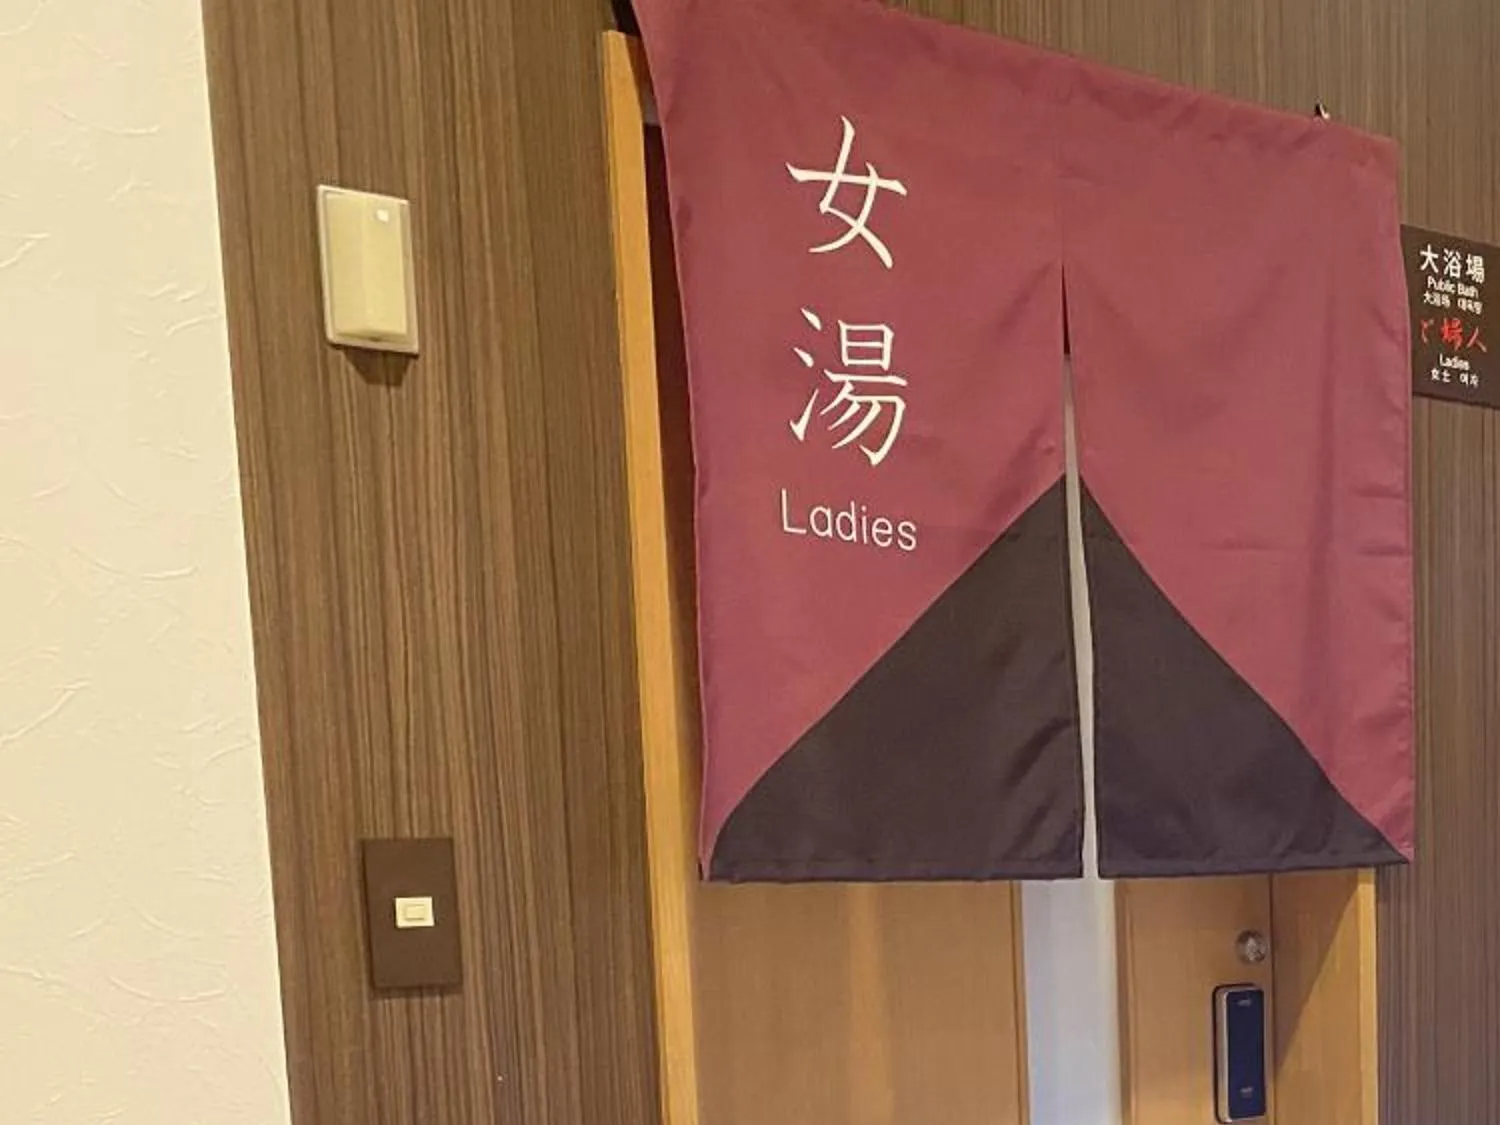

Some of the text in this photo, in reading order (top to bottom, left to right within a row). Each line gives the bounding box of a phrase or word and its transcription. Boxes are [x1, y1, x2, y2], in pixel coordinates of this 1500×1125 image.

[1419, 243, 1486, 284] 大浴場
[785, 114, 908, 467] 女湯
[1427, 274, 1478, 299] Public Bath
[1439, 352, 1470, 370] Ladies
[781, 487, 918, 552] Ladies
